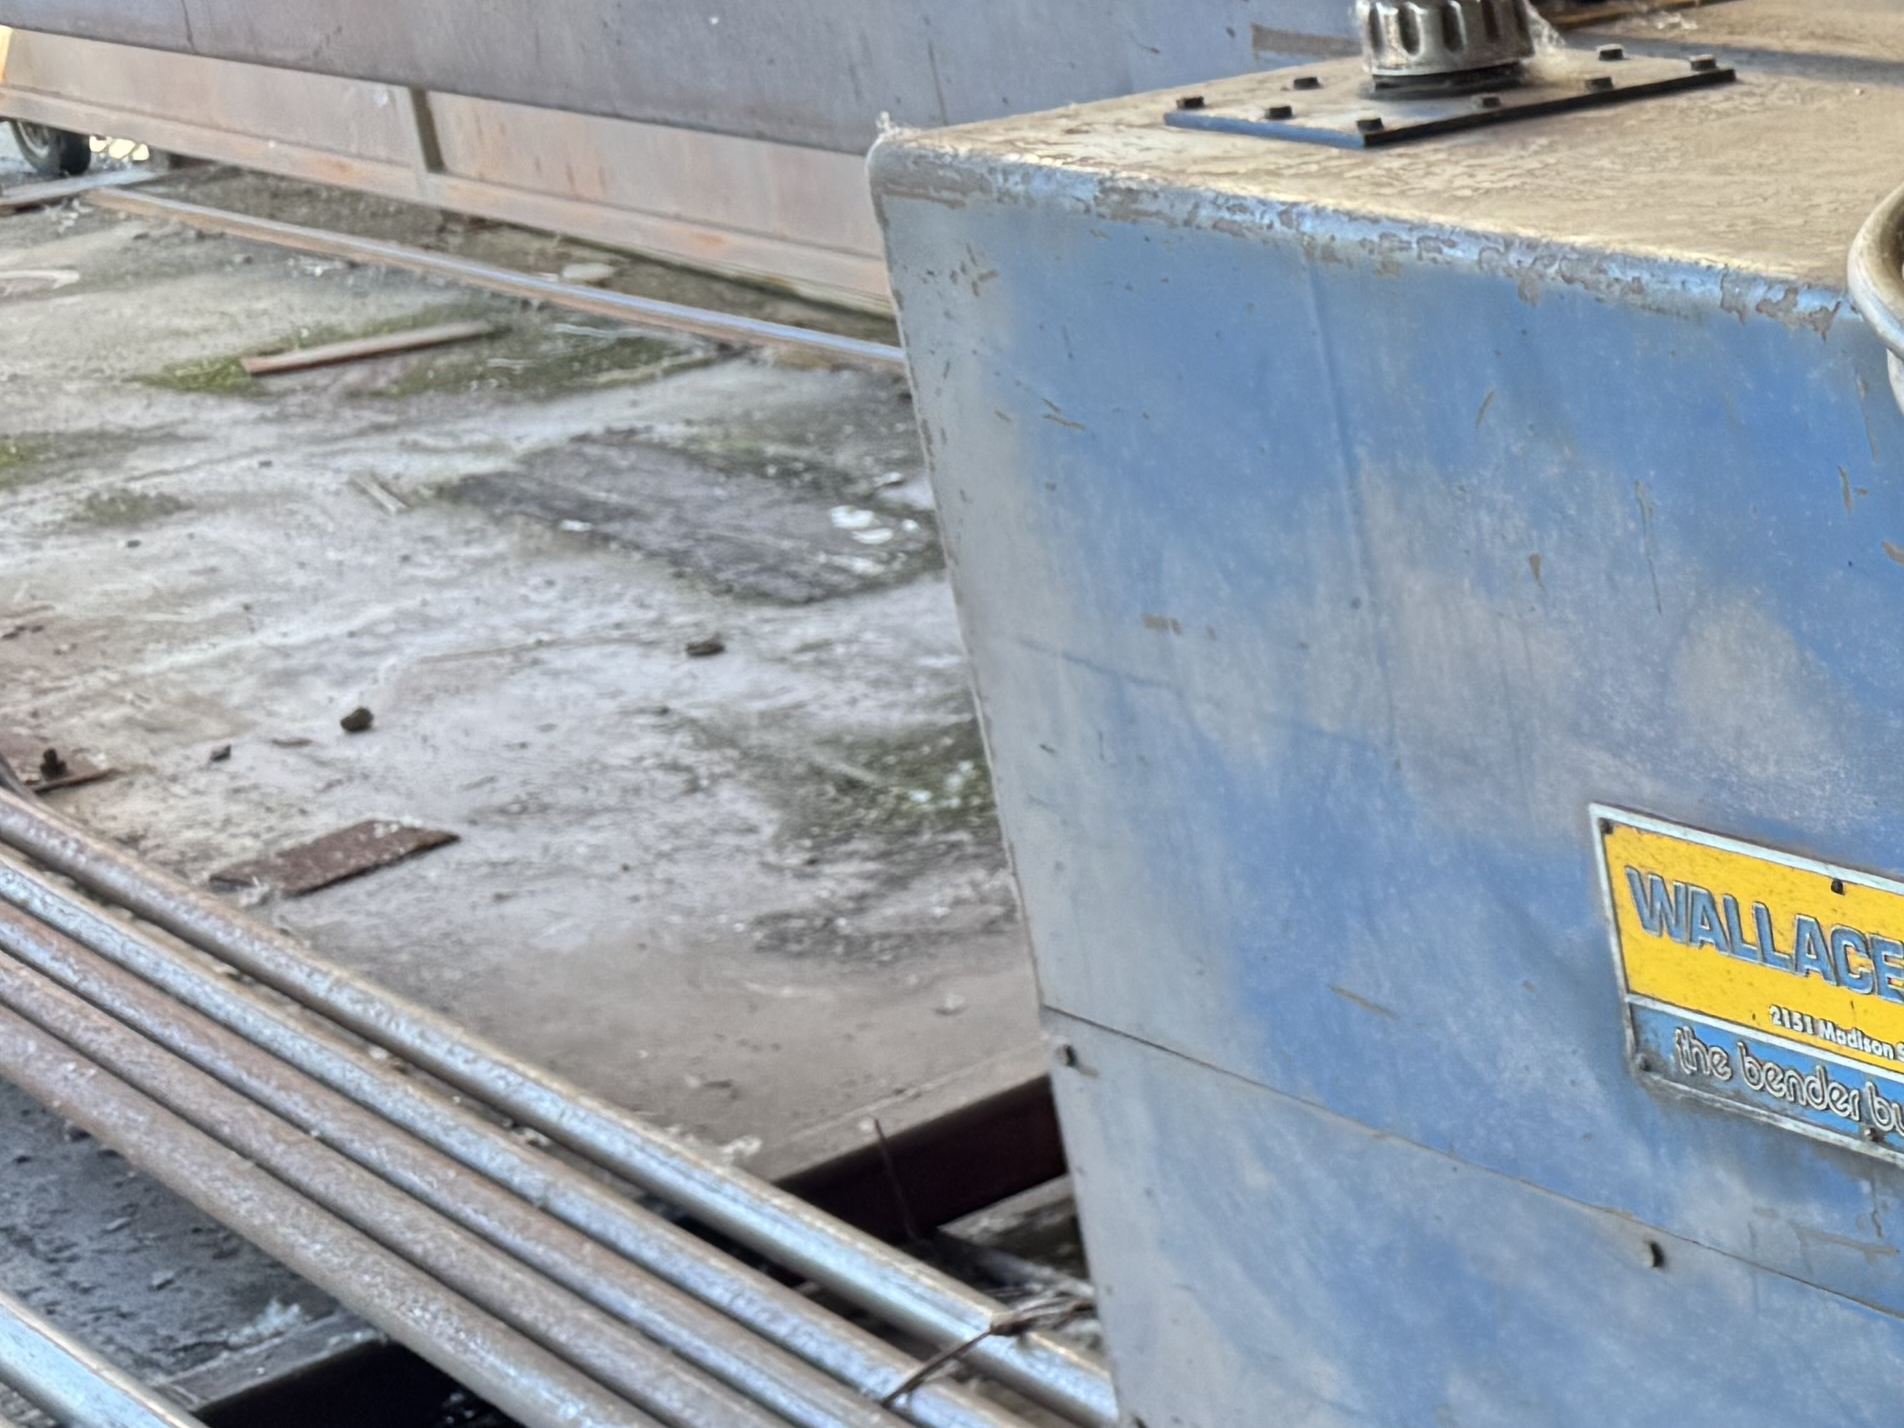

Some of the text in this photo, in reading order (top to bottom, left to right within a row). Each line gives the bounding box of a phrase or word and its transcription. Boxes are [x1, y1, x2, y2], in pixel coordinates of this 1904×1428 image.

[1769, 1005, 1815, 1035] 2151
[1817, 1018, 1895, 1061] Madison
[1674, 1026, 1732, 1081] the
[1737, 1041, 1860, 1122] bender
